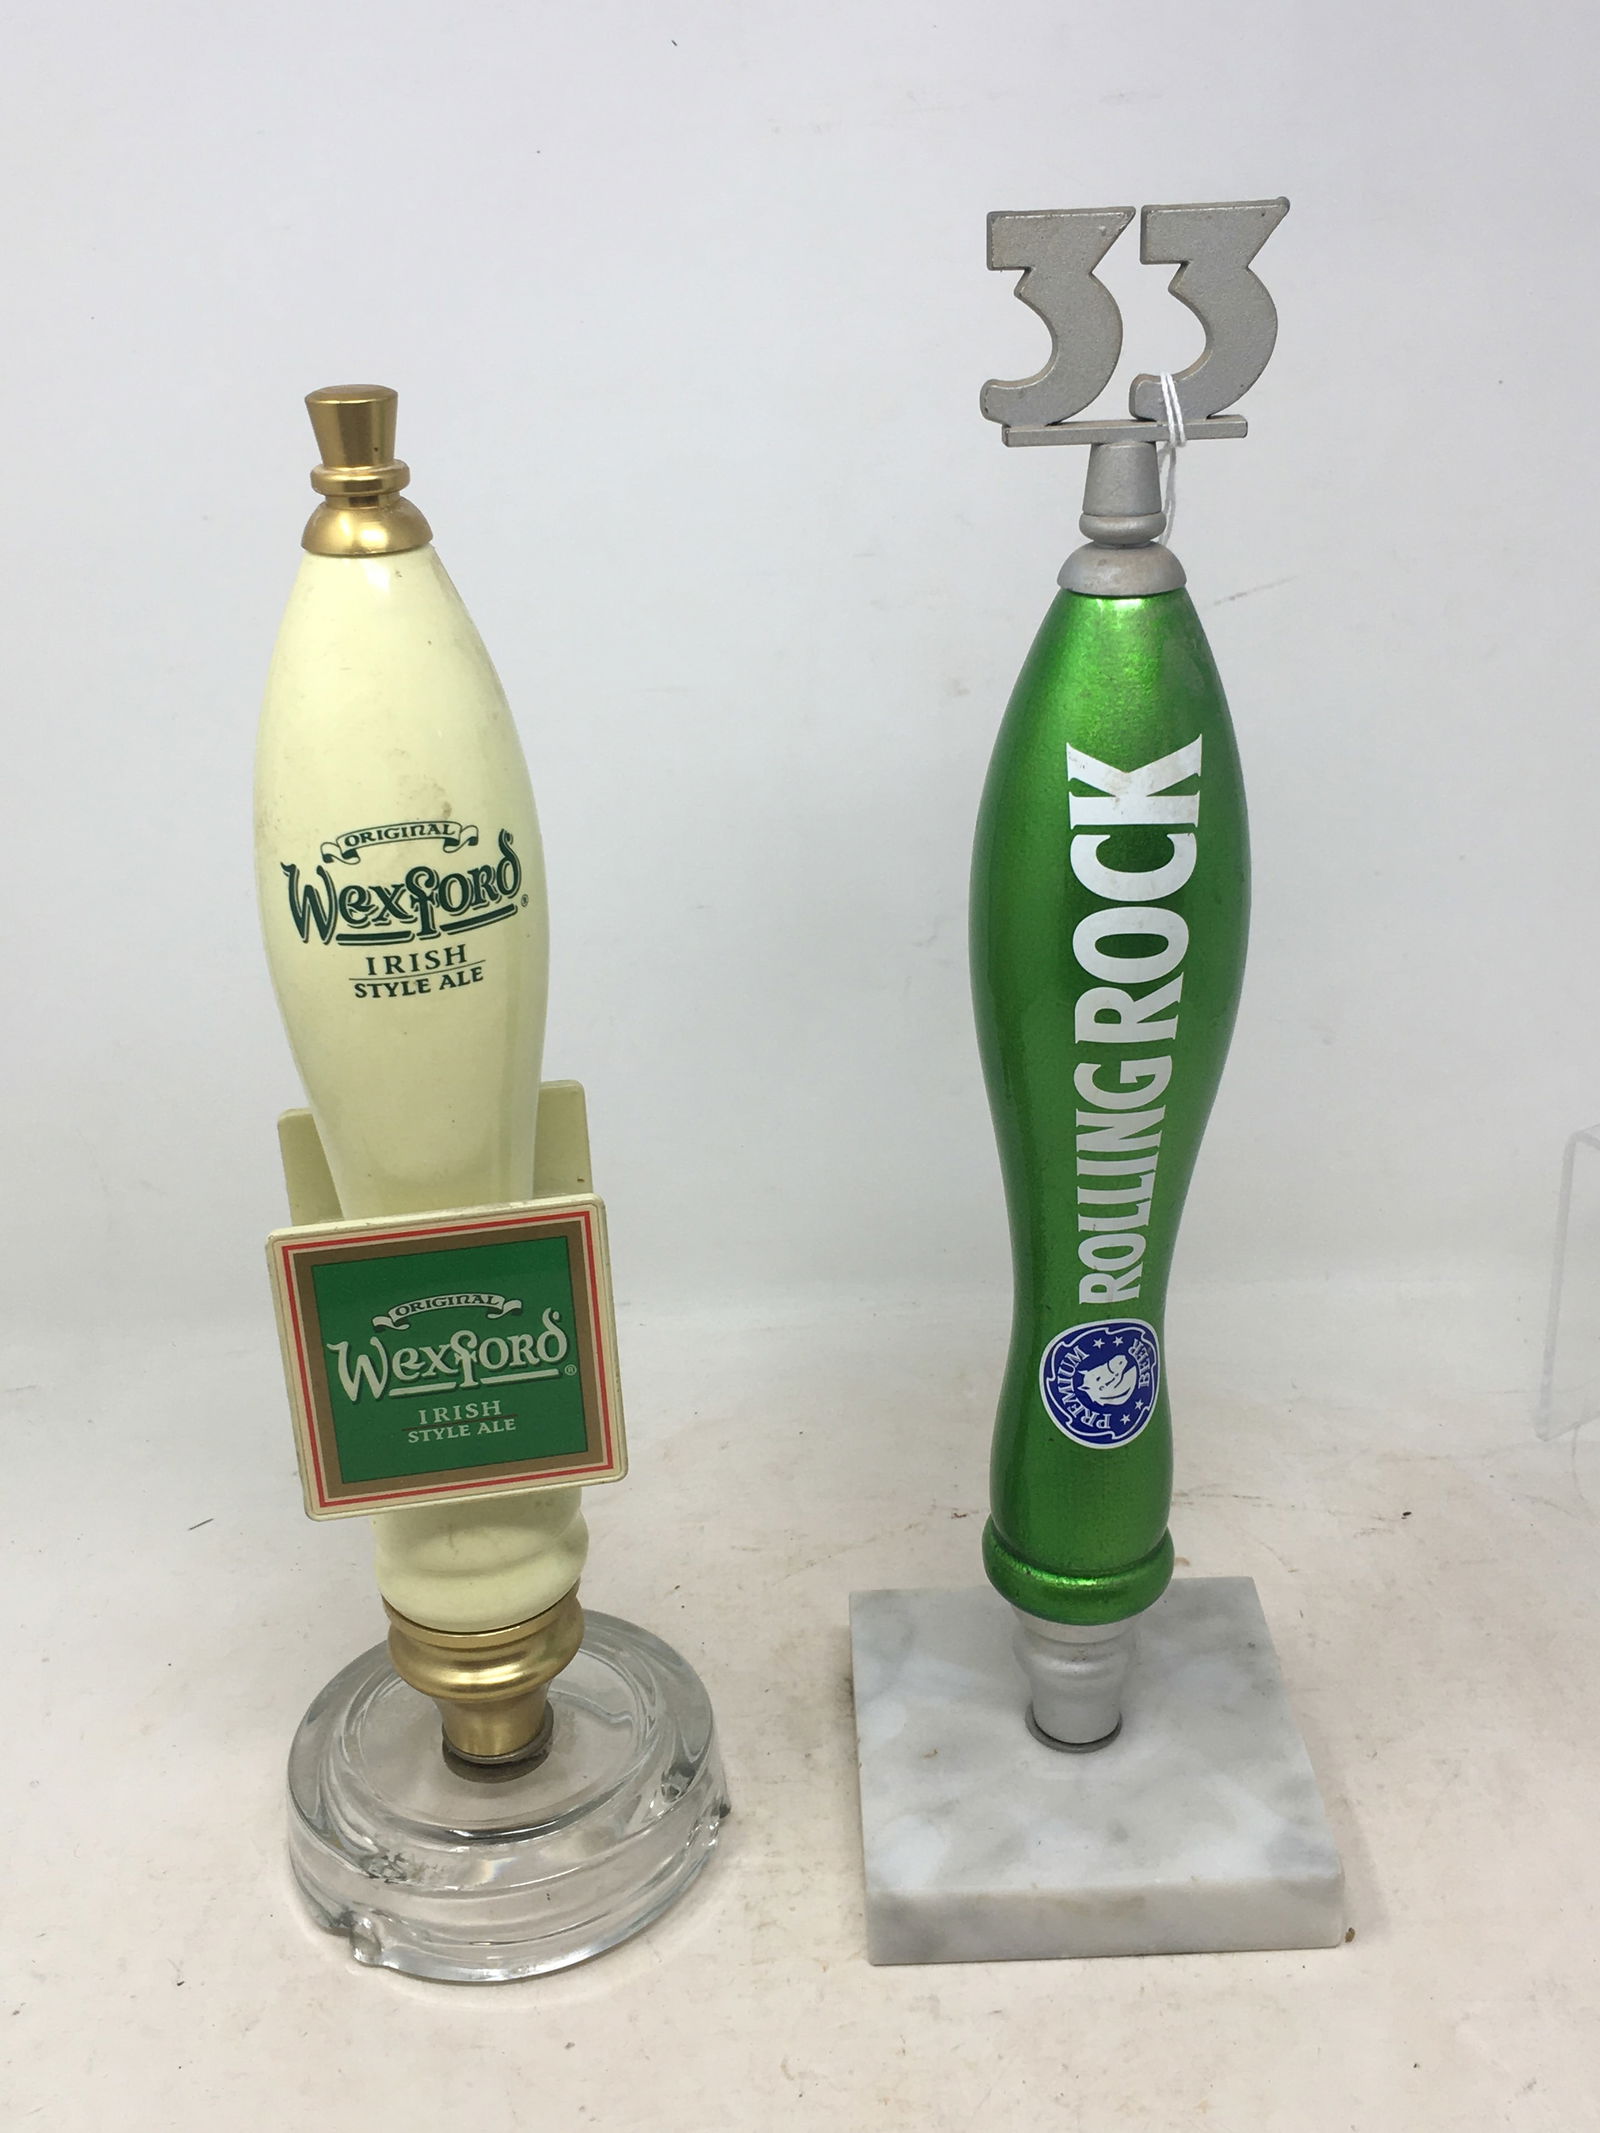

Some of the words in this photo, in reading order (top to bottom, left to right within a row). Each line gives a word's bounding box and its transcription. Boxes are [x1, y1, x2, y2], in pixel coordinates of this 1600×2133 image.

[980, 196, 1290, 427] 33
[343, 822, 456, 848] ORIGINAL
[281, 828, 522, 945] Wexford
[1066, 733, 1202, 1044] ROCK
[354, 979, 431, 999] STYLE
[439, 966, 484, 990] ALE
[365, 944, 468, 976] IRISH
[1073, 1055, 1173, 1305] ROLLING
[395, 1293, 502, 1317] ORIGINAL
[327, 1307, 569, 1402] Wexford
[1057, 1345, 1112, 1429] PREMIUM
[1128, 1338, 1151, 1390] BEER
[408, 1424, 471, 1443] STYLE
[477, 1418, 516, 1434] ALE
[418, 1400, 502, 1425] IRISH
